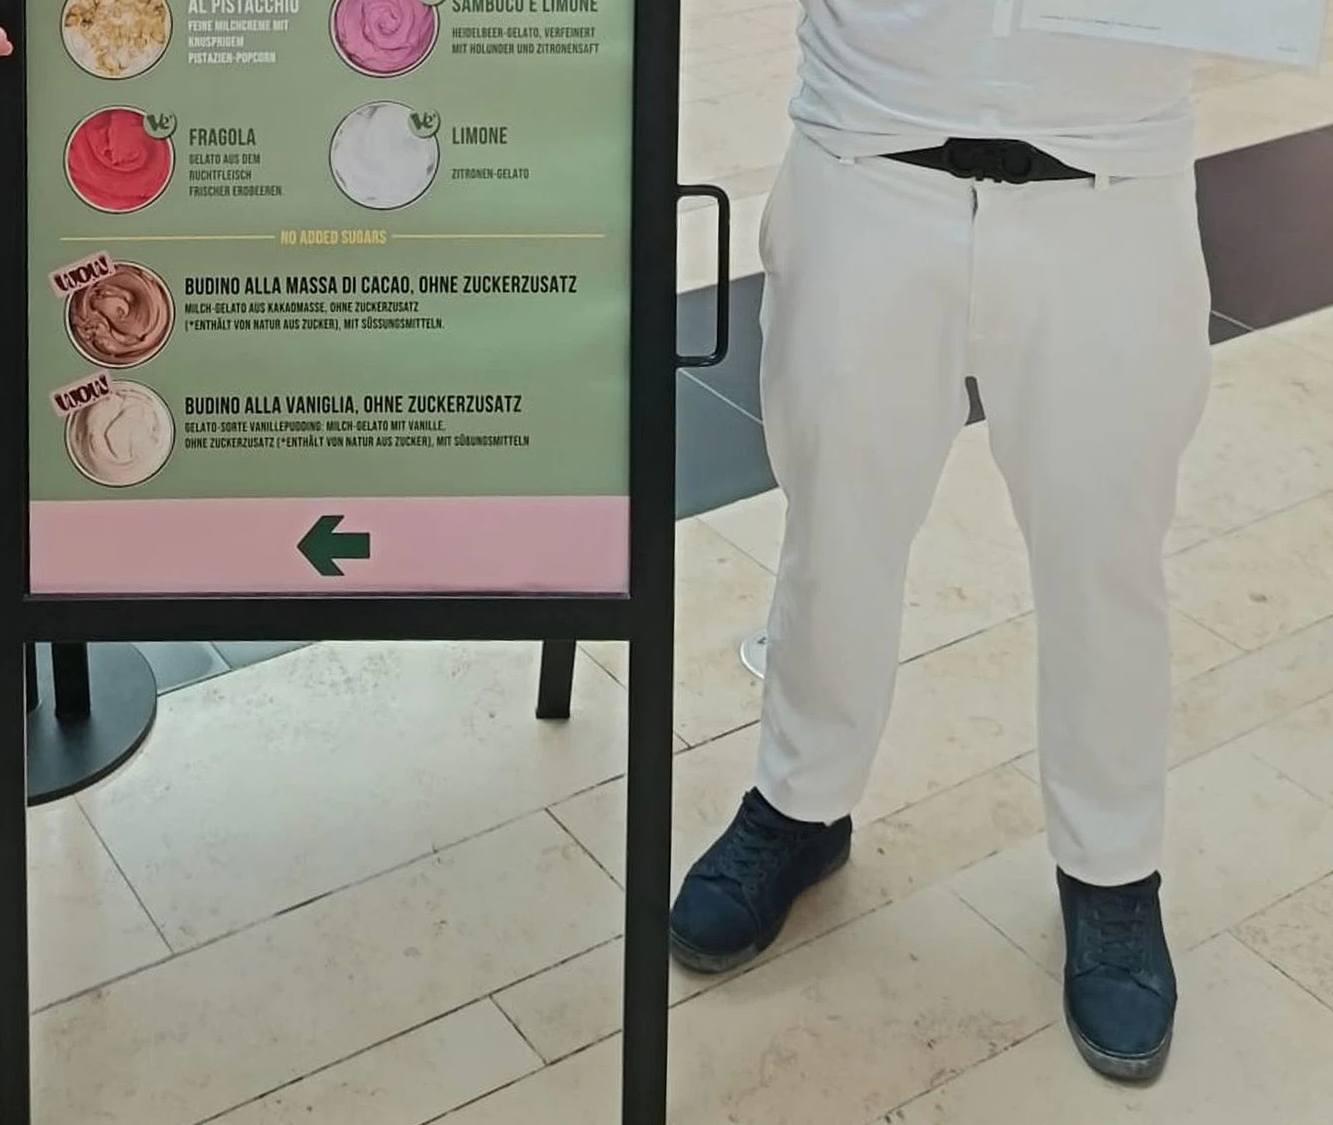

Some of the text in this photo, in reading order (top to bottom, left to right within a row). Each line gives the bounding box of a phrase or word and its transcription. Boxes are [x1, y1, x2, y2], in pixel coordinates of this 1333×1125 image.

[188, 20, 213, 32] FEINE
[273, 20, 289, 32] MIT
[544, 26, 595, 38] VERFEINERT
[452, 42, 600, 55] MIT HOLUNDER UND ZITRONENSAFT
[188, 52, 277, 64] PISTAZIEN-POPCORN
[189, 128, 256, 146] FRAGOLA
[452, 127, 508, 145] LIMONE
[189, 153, 260, 165] GELATO AUS DEM
[451, 167, 530, 180] ZITRONEN-GELATO
[189, 186, 230, 197] FRISCHER
[280, 229, 387, 245] NO ADDED SUGARS
[185, 275, 577, 296] BUDINO ALLA MASSA DI CACAO, OHNE ZUCKERZUSATZ
[185, 302, 247, 314] MILCH-GELATO
[249, 302, 265, 313] AUS
[329, 301, 353, 313] OHNE
[355, 301, 419, 313] ZUCKERZUSATZ
[234, 319, 251, 330] VON
[253, 319, 281, 330] NATUR
[283, 319, 300, 330] AUS
[344, 319, 359, 329] MIT
[185, 395, 523, 416] BUDINO ALLA VANIGLIA, OHNE ZUCKERZUSATZ
[185, 422, 247, 433] GELATO-SORTE
[326, 421, 388, 432] MILCH-GELATO
[390, 420, 405, 431] MIT
[185, 437, 208, 449] OHNE
[210, 437, 275, 448] ZUCKERZUSATZ
[326, 436, 343, 447] VON
[346, 436, 374, 447] NATUR
[376, 436, 393, 447] AUS
[437, 436, 452, 447] MIT
